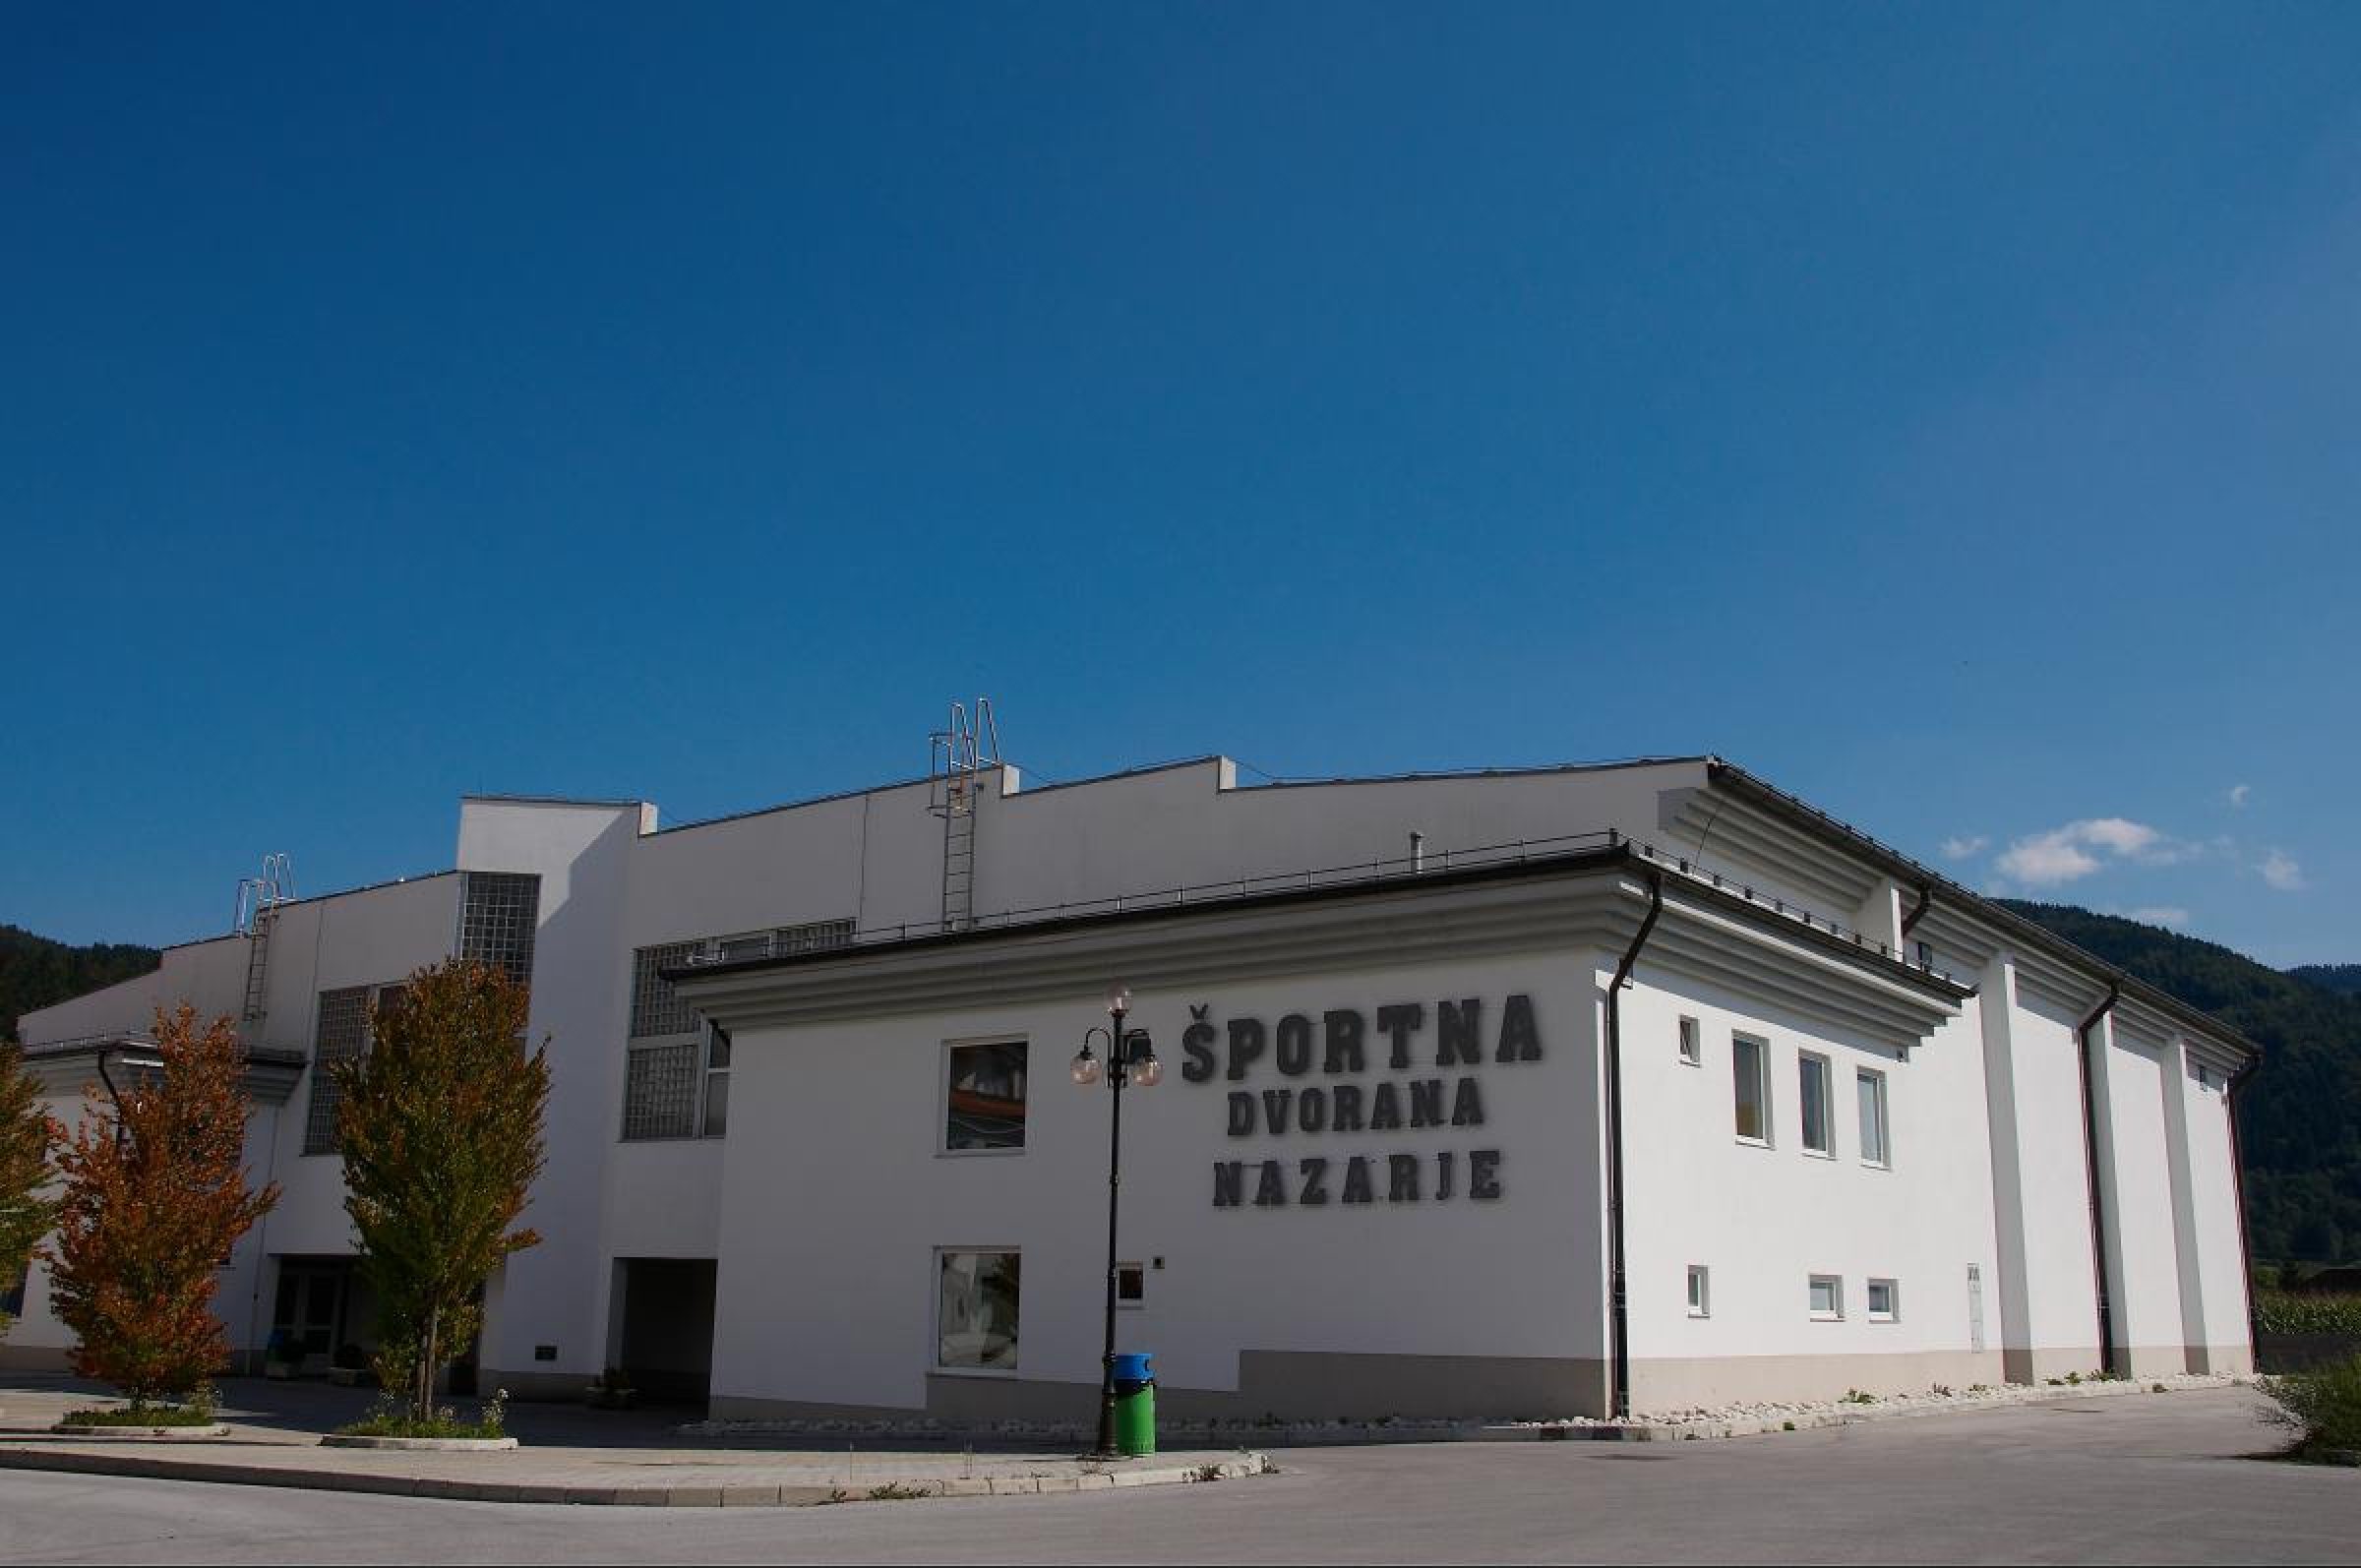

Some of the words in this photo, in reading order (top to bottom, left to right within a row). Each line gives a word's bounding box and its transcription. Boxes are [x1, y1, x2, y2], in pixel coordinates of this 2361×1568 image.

[1181, 995, 1543, 1082] ŠPORTNA
[1227, 1078, 1483, 1135] DVORANA
[1213, 1150, 1500, 1206] NAZARJE
